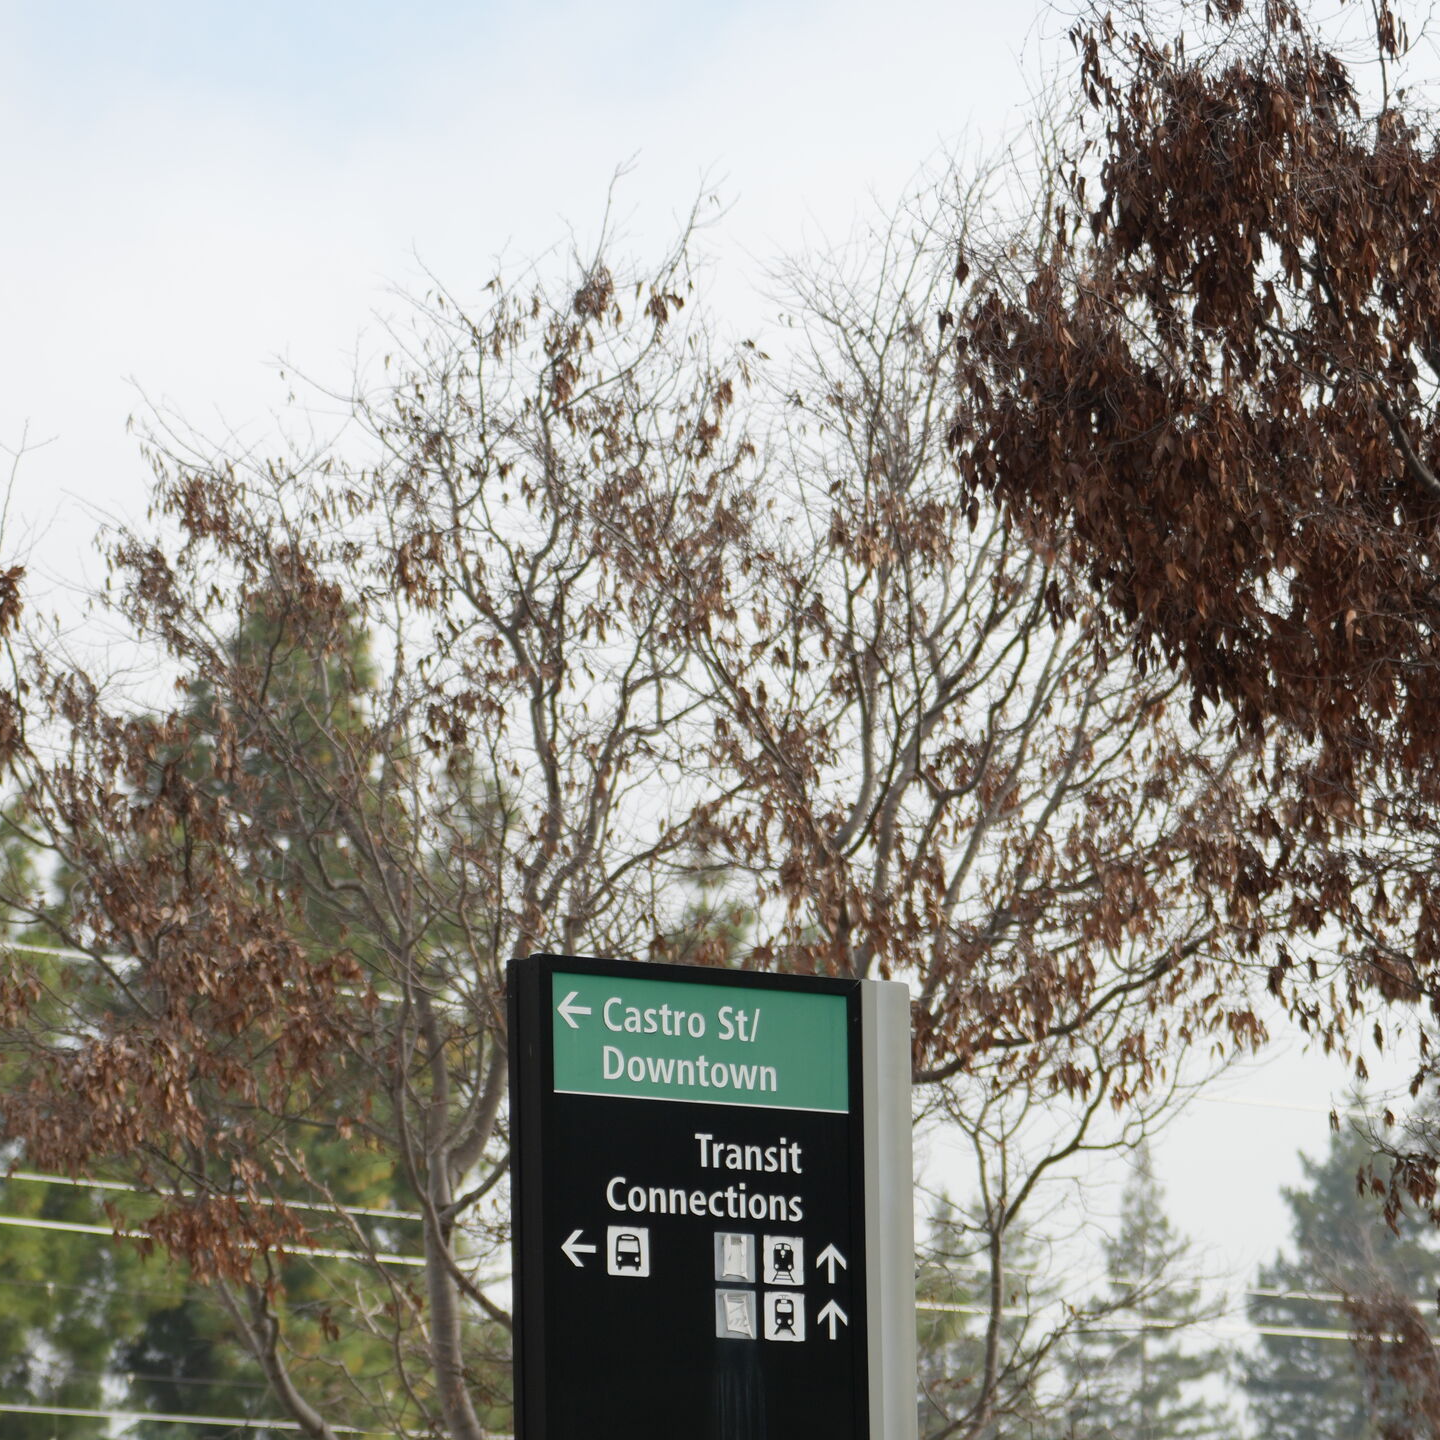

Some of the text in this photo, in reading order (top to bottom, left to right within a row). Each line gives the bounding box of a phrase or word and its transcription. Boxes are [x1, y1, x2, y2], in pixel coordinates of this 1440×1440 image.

[603, 997, 761, 1043] Castro St/
[602, 1045, 778, 1093] Downtown
[694, 1133, 803, 1174] Transit
[606, 1176, 804, 1222] Connections
